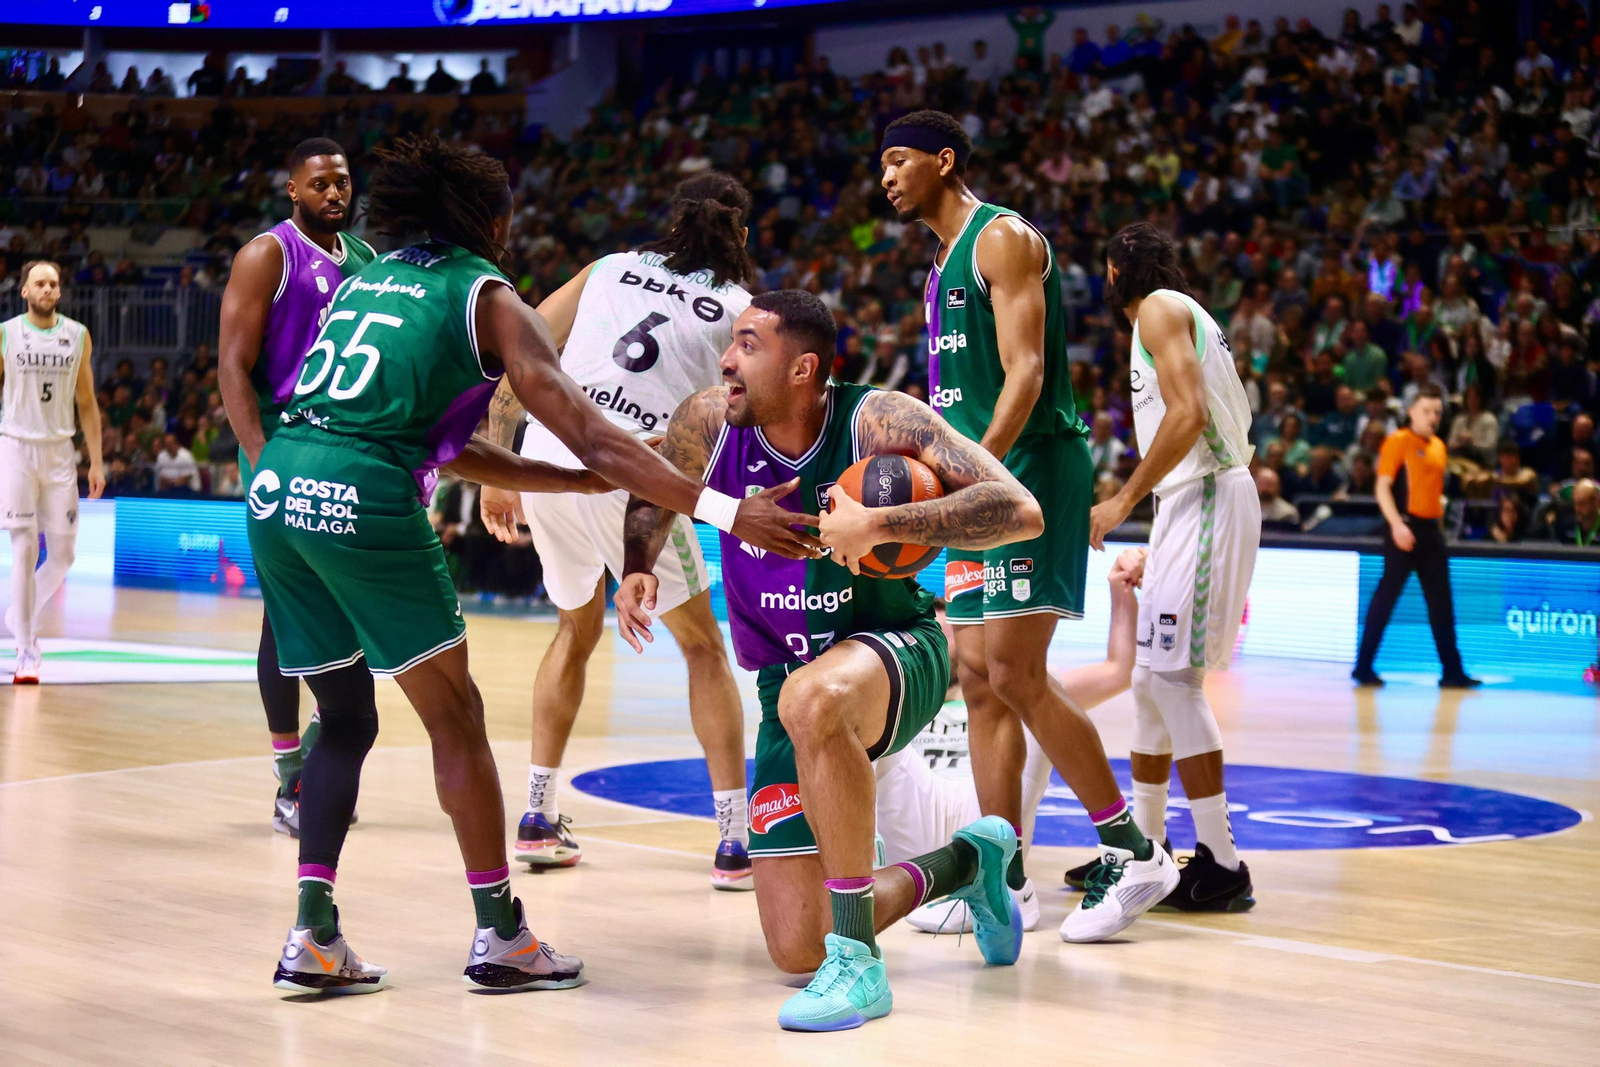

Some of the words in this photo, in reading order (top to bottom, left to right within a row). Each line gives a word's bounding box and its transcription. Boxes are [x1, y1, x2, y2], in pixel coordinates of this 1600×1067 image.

[612, 311, 671, 373] 6
[16, 352, 75, 368] surne
[294, 310, 404, 400] 55
[41, 382, 53, 403] 5
[288, 476, 360, 504] COSTA
[284, 495, 317, 515] DEL
[319, 501, 358, 519] SOL
[284, 512, 357, 535] MÁLAGA
[1012, 563, 1029, 571] acb
[760, 584, 853, 613] málaga
[923, 749, 969, 770] 77
